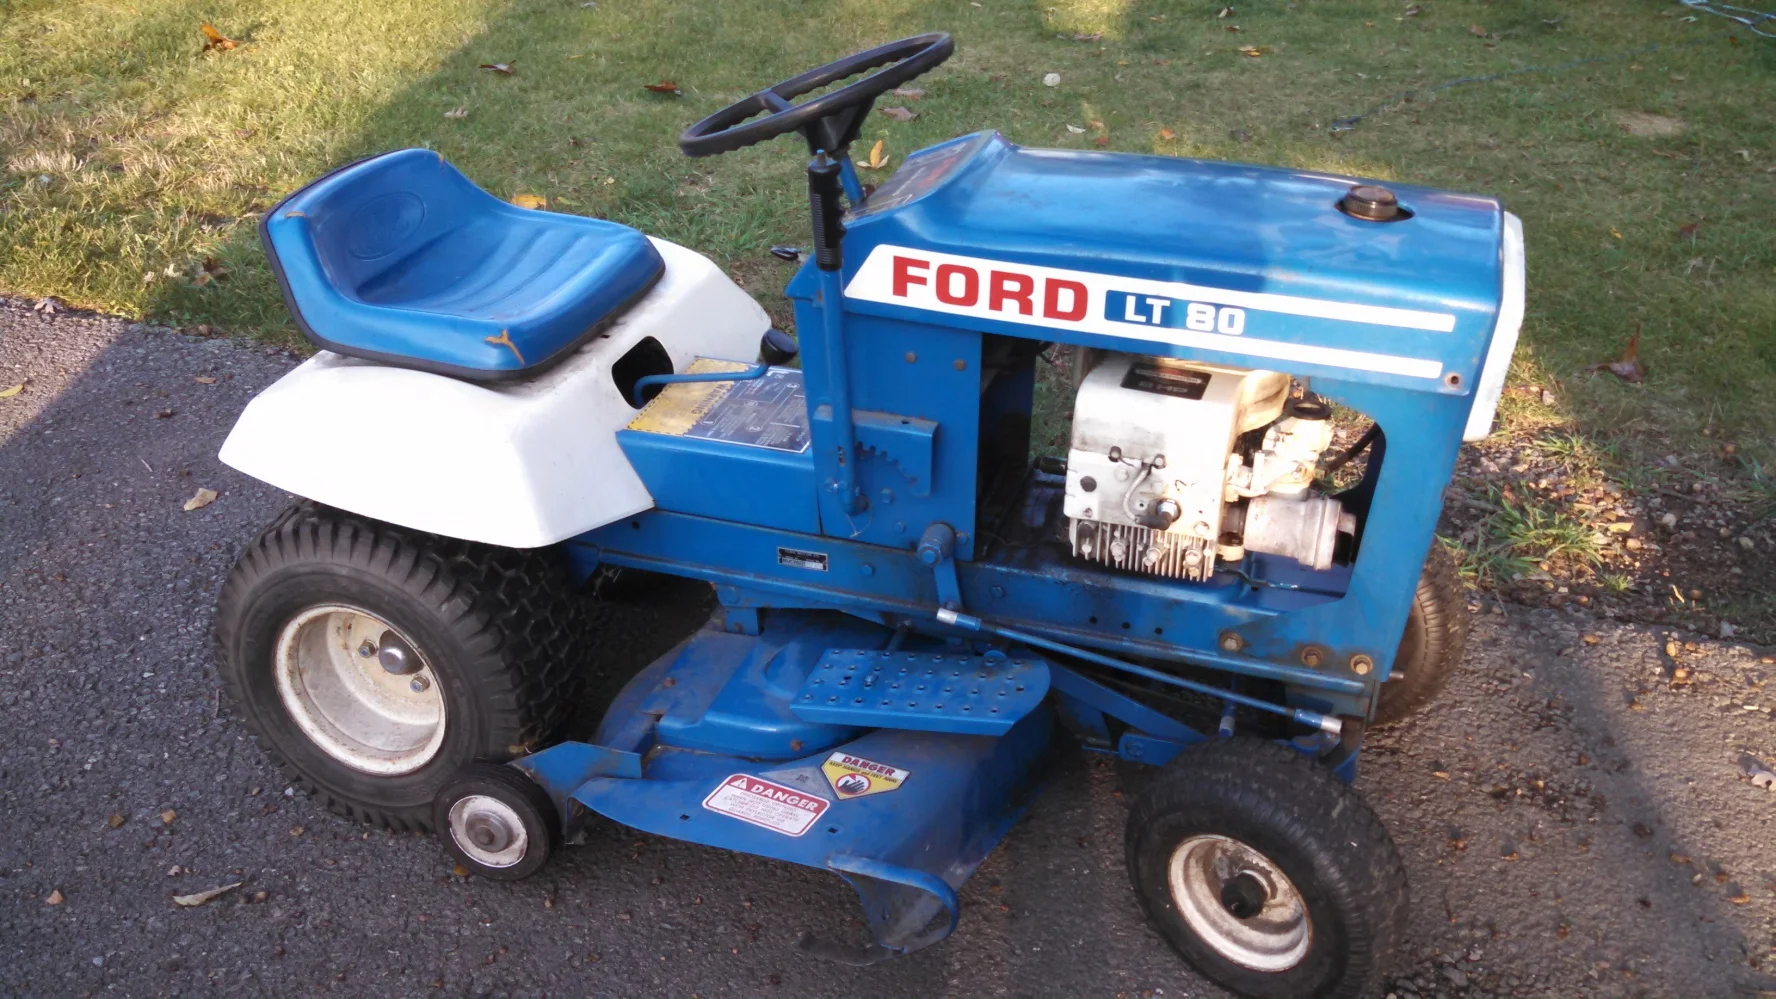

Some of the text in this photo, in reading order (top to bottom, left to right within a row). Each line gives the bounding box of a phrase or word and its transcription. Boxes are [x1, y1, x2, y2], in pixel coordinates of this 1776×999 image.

[892, 255, 1246, 335] FORD LT 80
[841, 756, 896, 776] DANGER
[751, 784, 819, 811] DANGER
